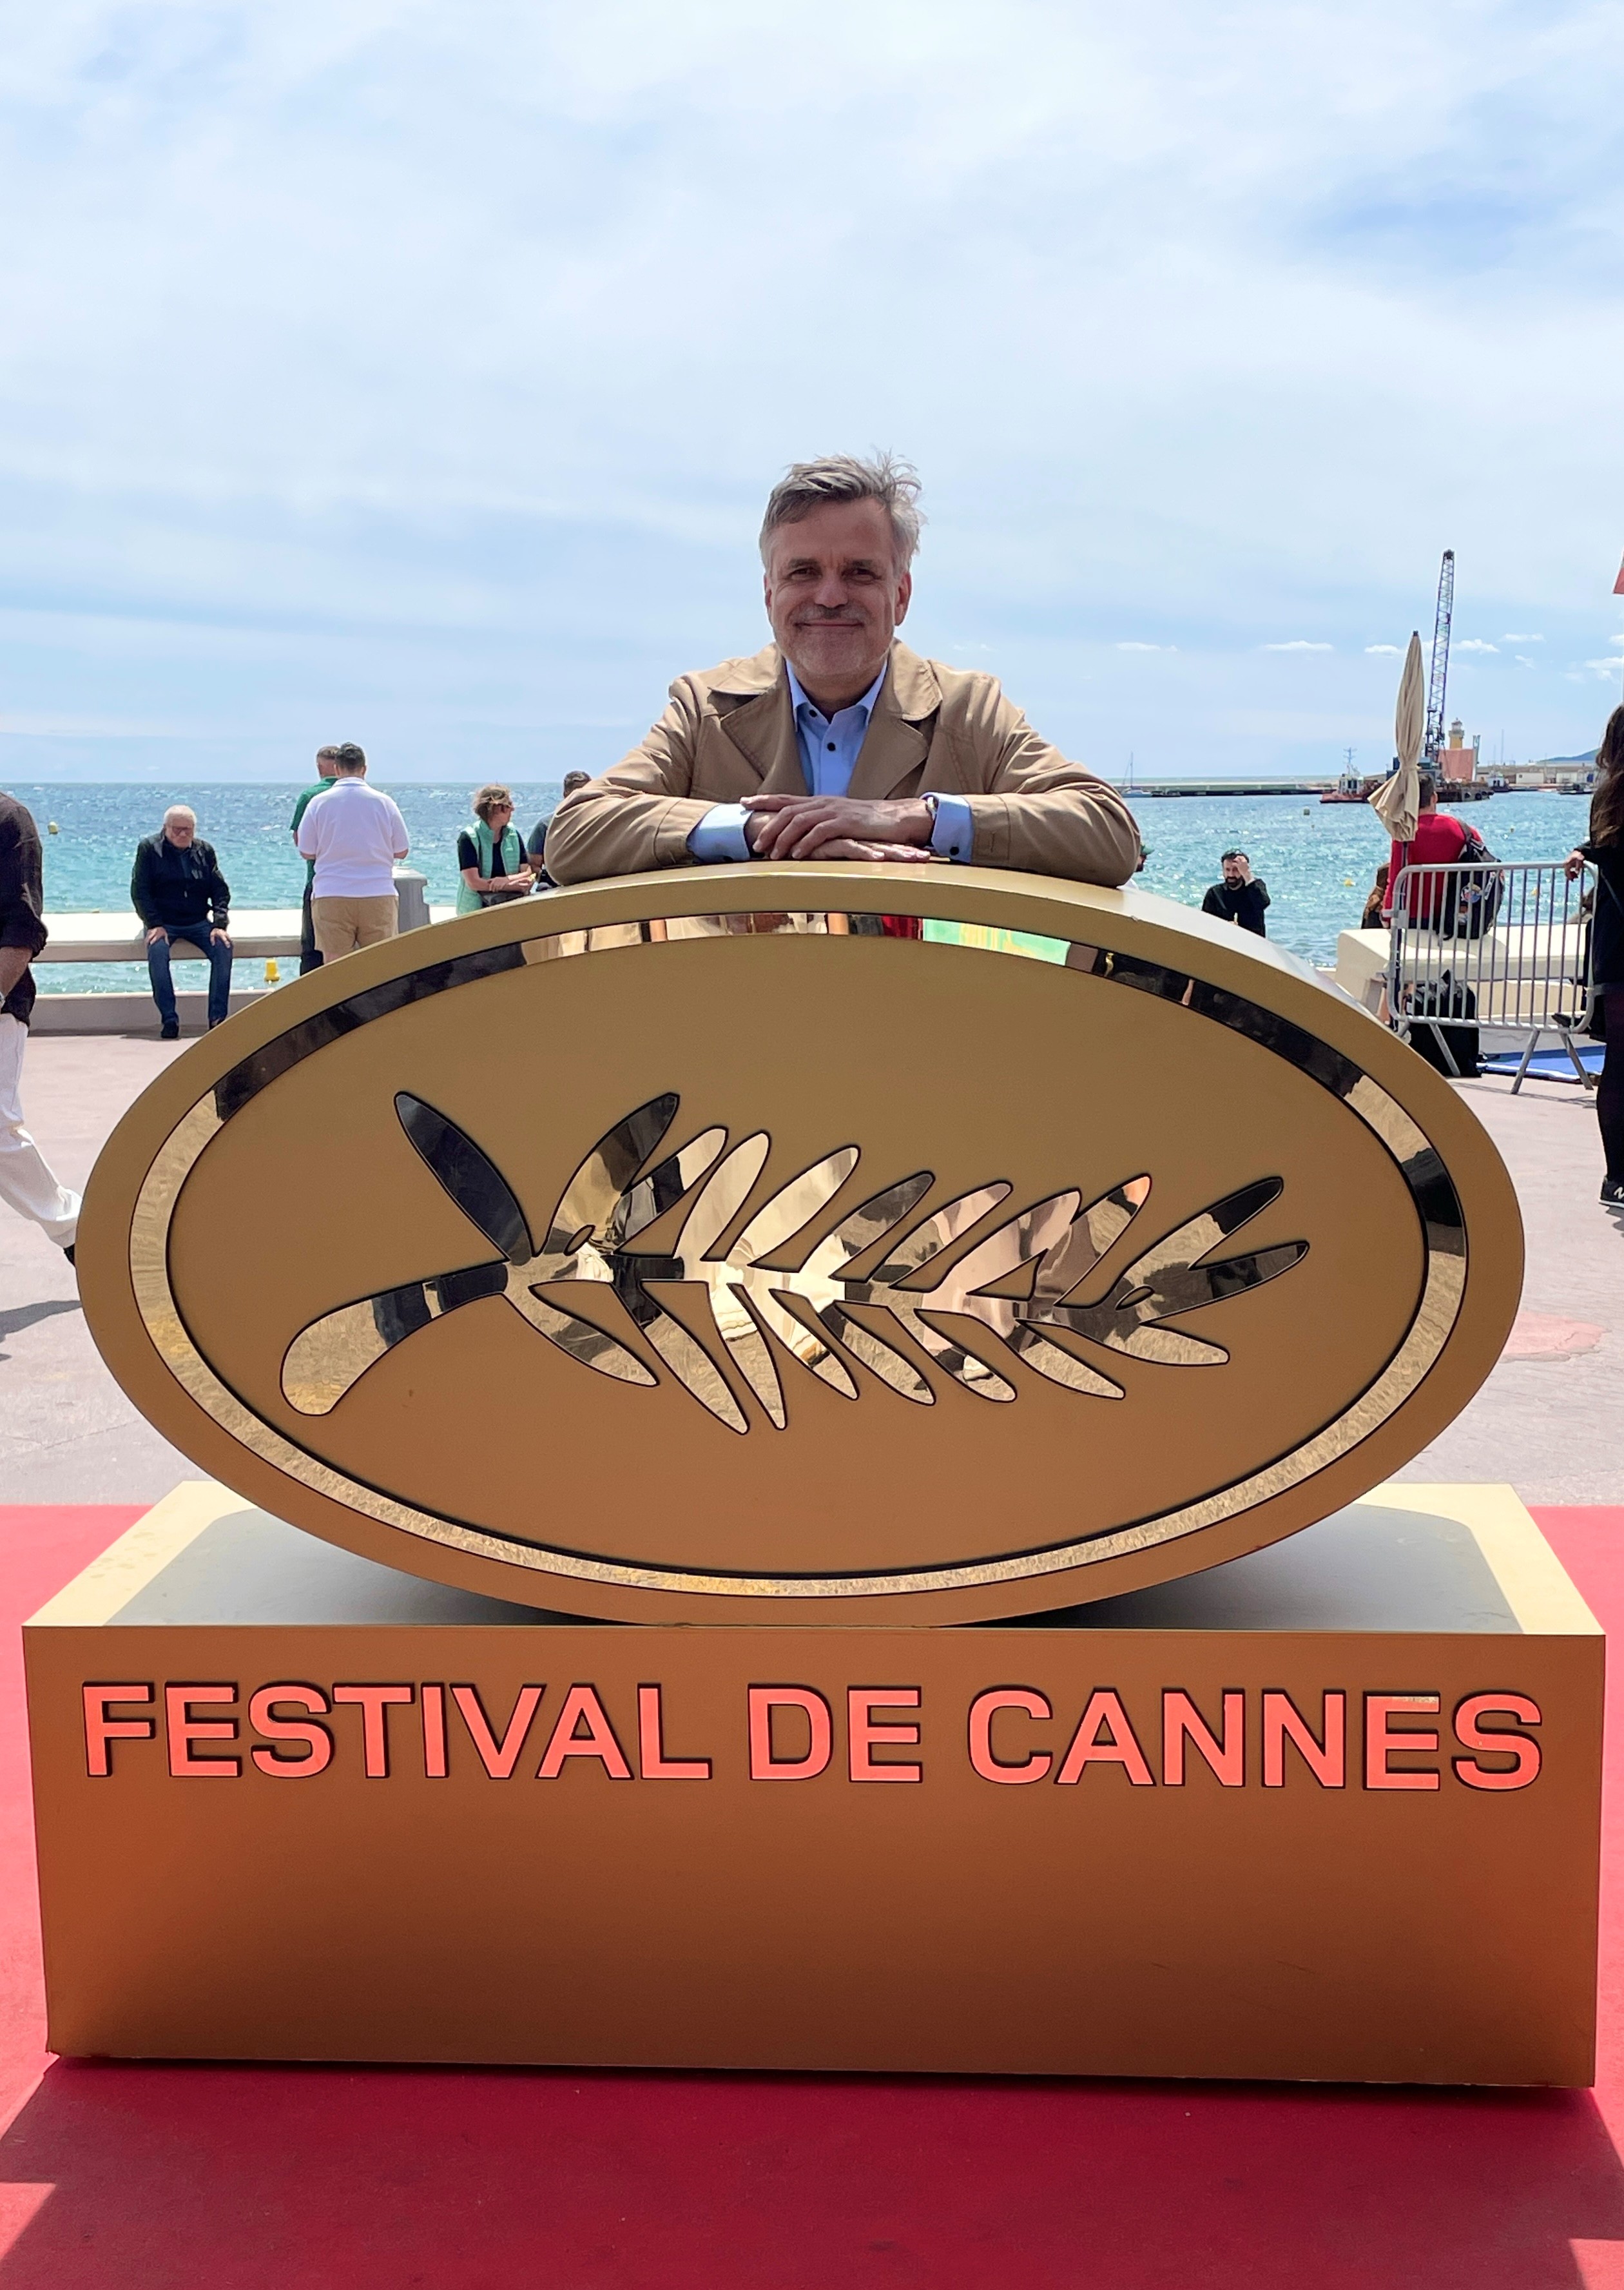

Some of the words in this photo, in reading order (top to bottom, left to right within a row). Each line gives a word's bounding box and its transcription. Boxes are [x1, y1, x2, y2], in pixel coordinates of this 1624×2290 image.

[82, 1682, 712, 1780] FESTIVAL
[748, 1684, 923, 1783] DE
[966, 1685, 1543, 1792] CANNES
